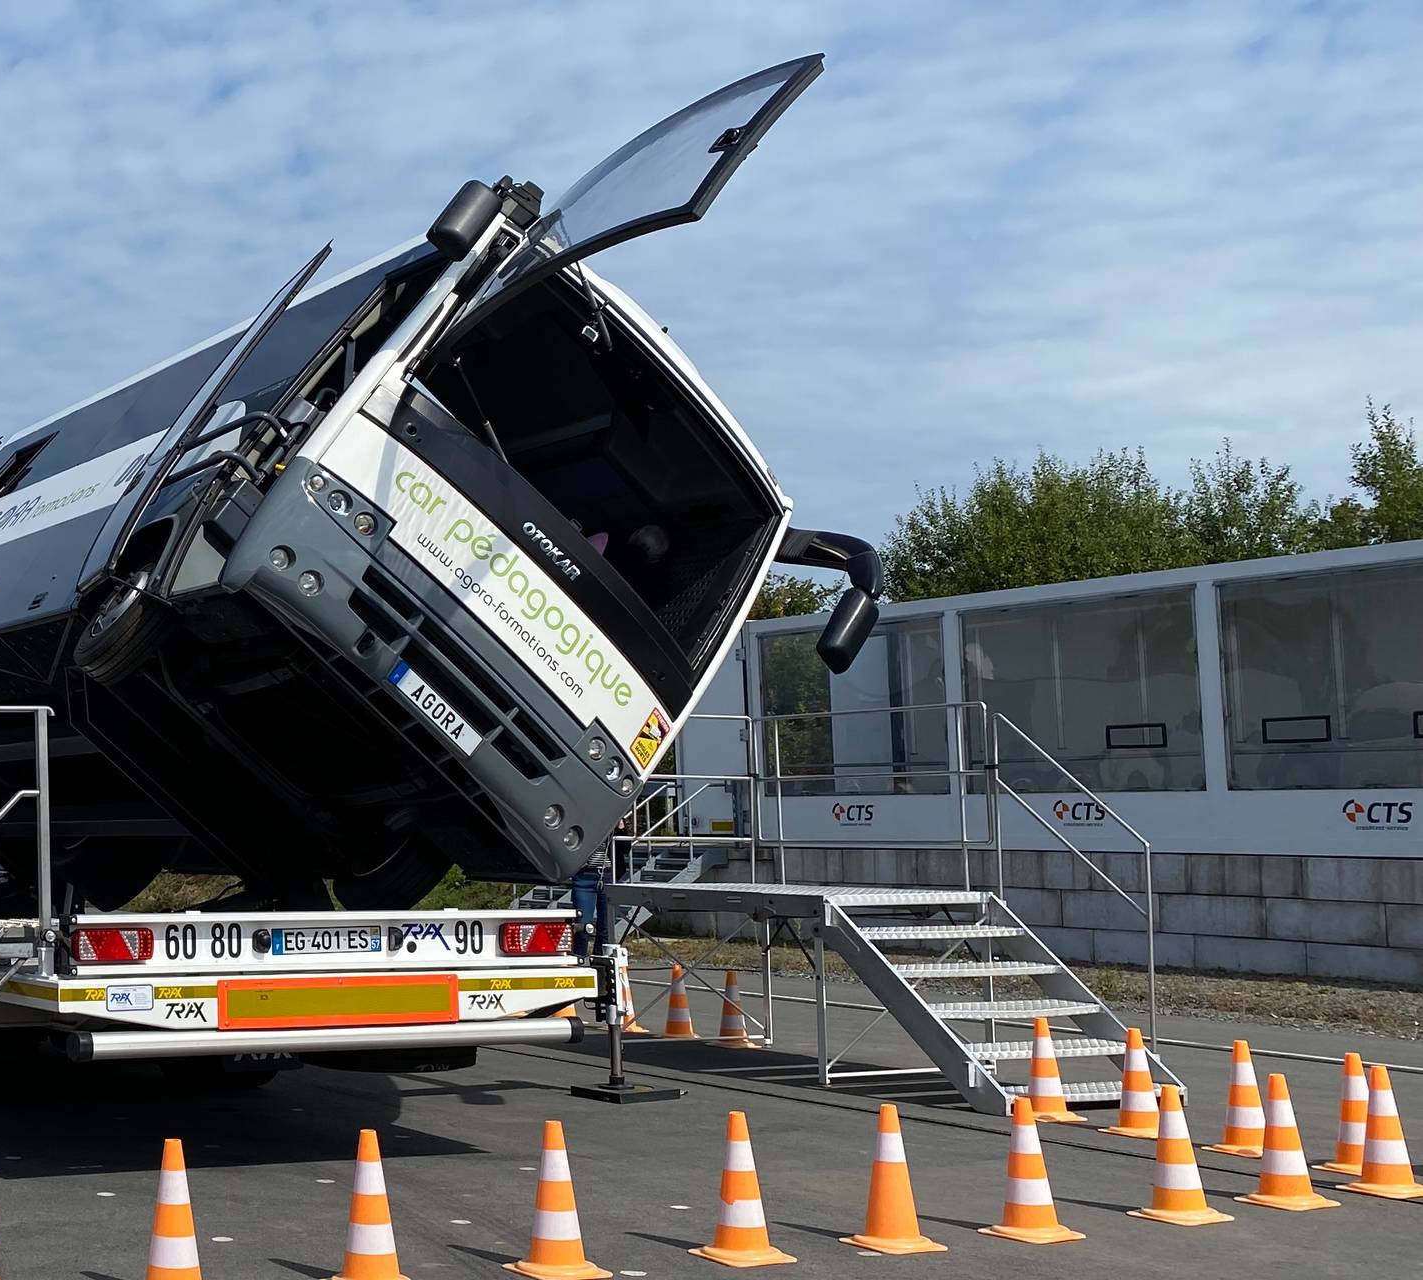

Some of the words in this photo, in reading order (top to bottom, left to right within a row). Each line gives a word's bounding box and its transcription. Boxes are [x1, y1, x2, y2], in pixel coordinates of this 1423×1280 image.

[522, 521, 582, 582] OTOKAR
[395, 471, 447, 515] car
[442, 518, 633, 707] pédagogique
[417, 532, 585, 699] www.agora-formations.com
[410, 684, 465, 740] AGORA
[846, 804, 874, 821] CTS
[1071, 802, 1106, 821] CTS
[1366, 802, 1413, 824] CTS
[165, 924, 197, 960] 60
[210, 922, 242, 959] 80
[284, 929, 369, 952] EG-401-ES
[370, 938, 381, 950] 57
[401, 922, 451, 951] TRAX
[454, 920, 484, 955] 90
[157, 986, 182, 999] TRAX
[490, 979, 512, 989] TRAX
[553, 976, 576, 988] TRAX
[85, 989, 105, 1000] TRA
[110, 992, 133, 1006] TRAX
[468, 993, 507, 1014] TRAX
[165, 1001, 208, 1023] TRAX
